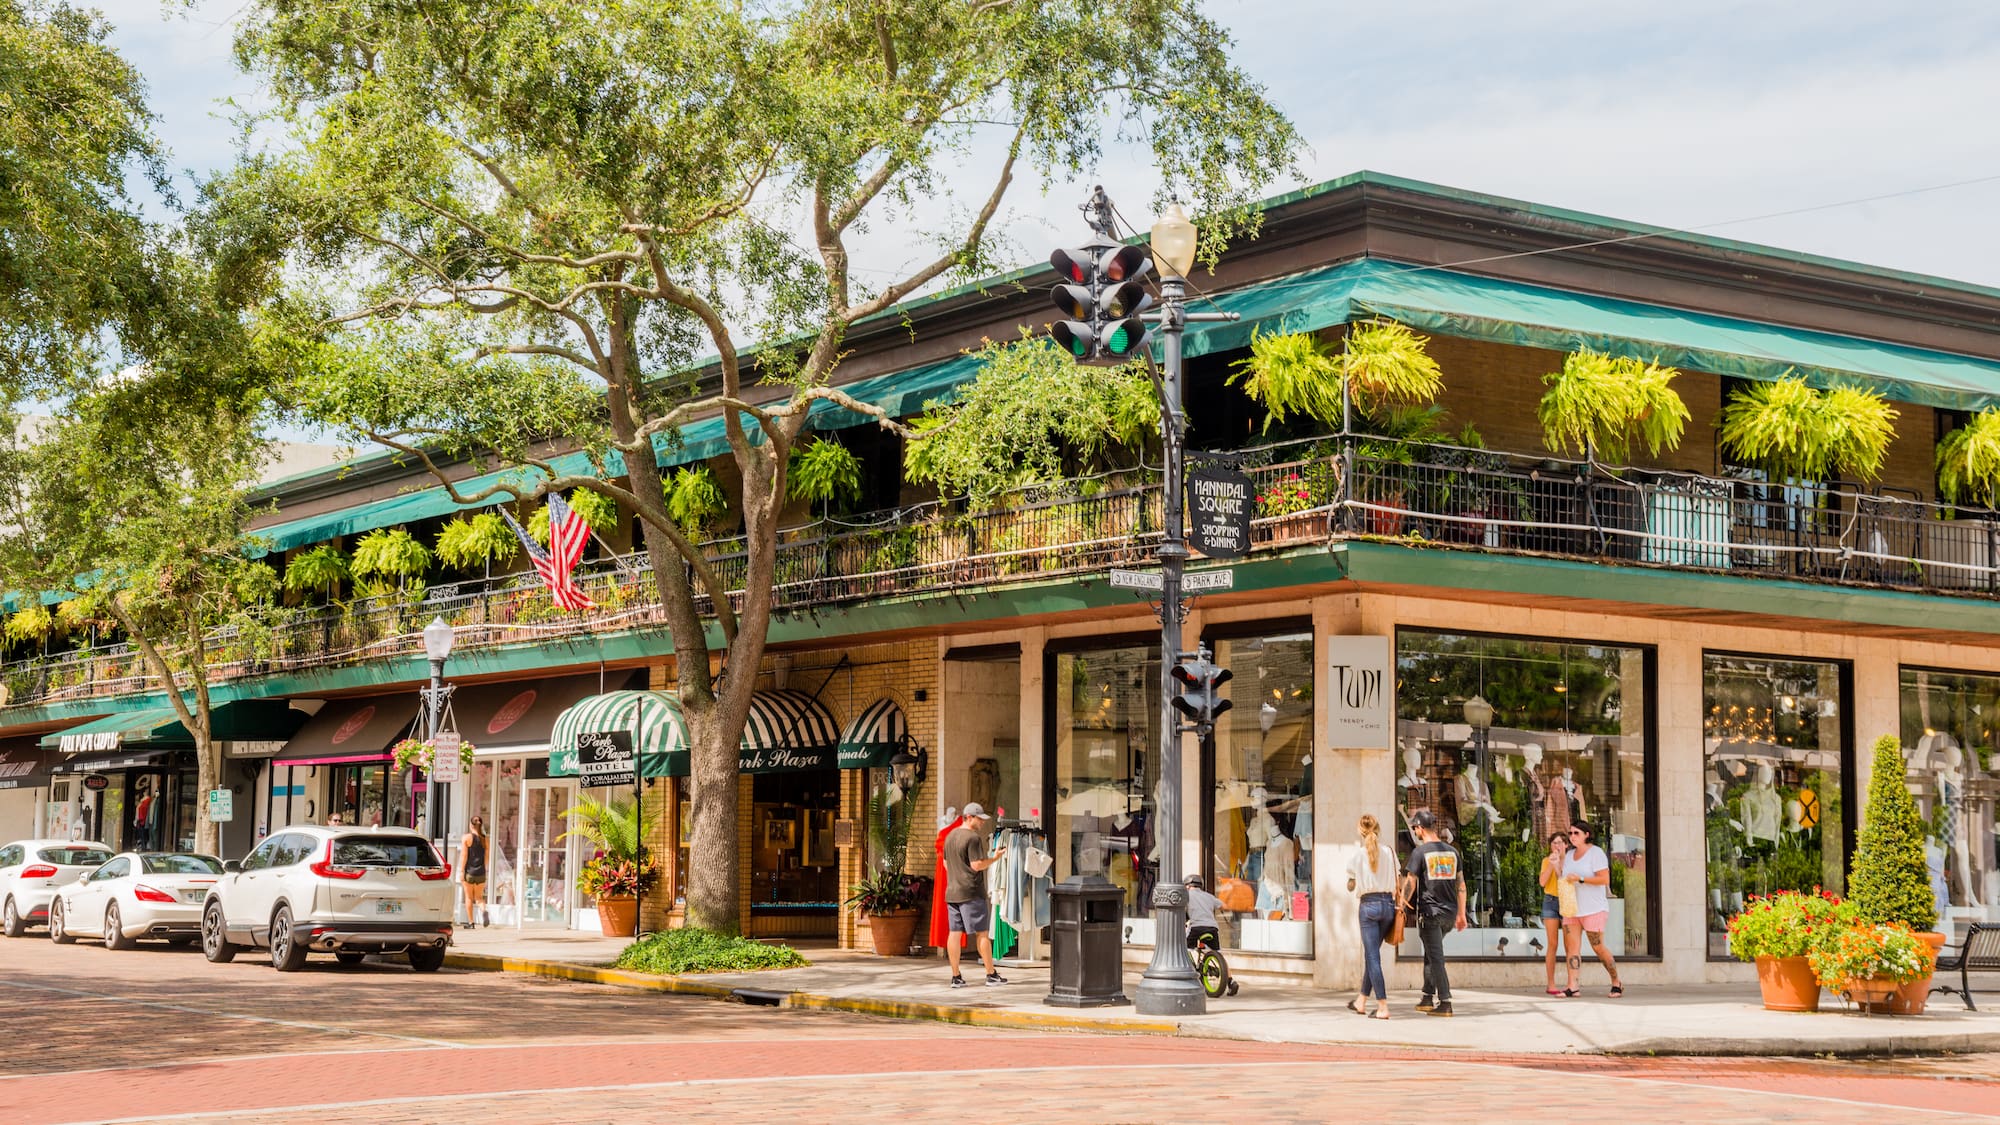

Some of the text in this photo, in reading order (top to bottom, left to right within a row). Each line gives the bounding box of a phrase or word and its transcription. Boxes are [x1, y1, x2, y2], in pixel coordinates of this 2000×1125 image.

[1195, 480, 1247, 499] HANNIBAL
[1198, 496, 1243, 515] SQUARE
[1201, 524, 1240, 538] SHOPPING
[1122, 574, 1132, 584] NEW
[1193, 576, 1211, 587] PARK
[1214, 574, 1228, 585] AVE
[579, 732, 612, 749] Park
[594, 744, 631, 764] Plaza
[768, 749, 822, 768] Plaza
[586, 762, 629, 772] HOTEL
